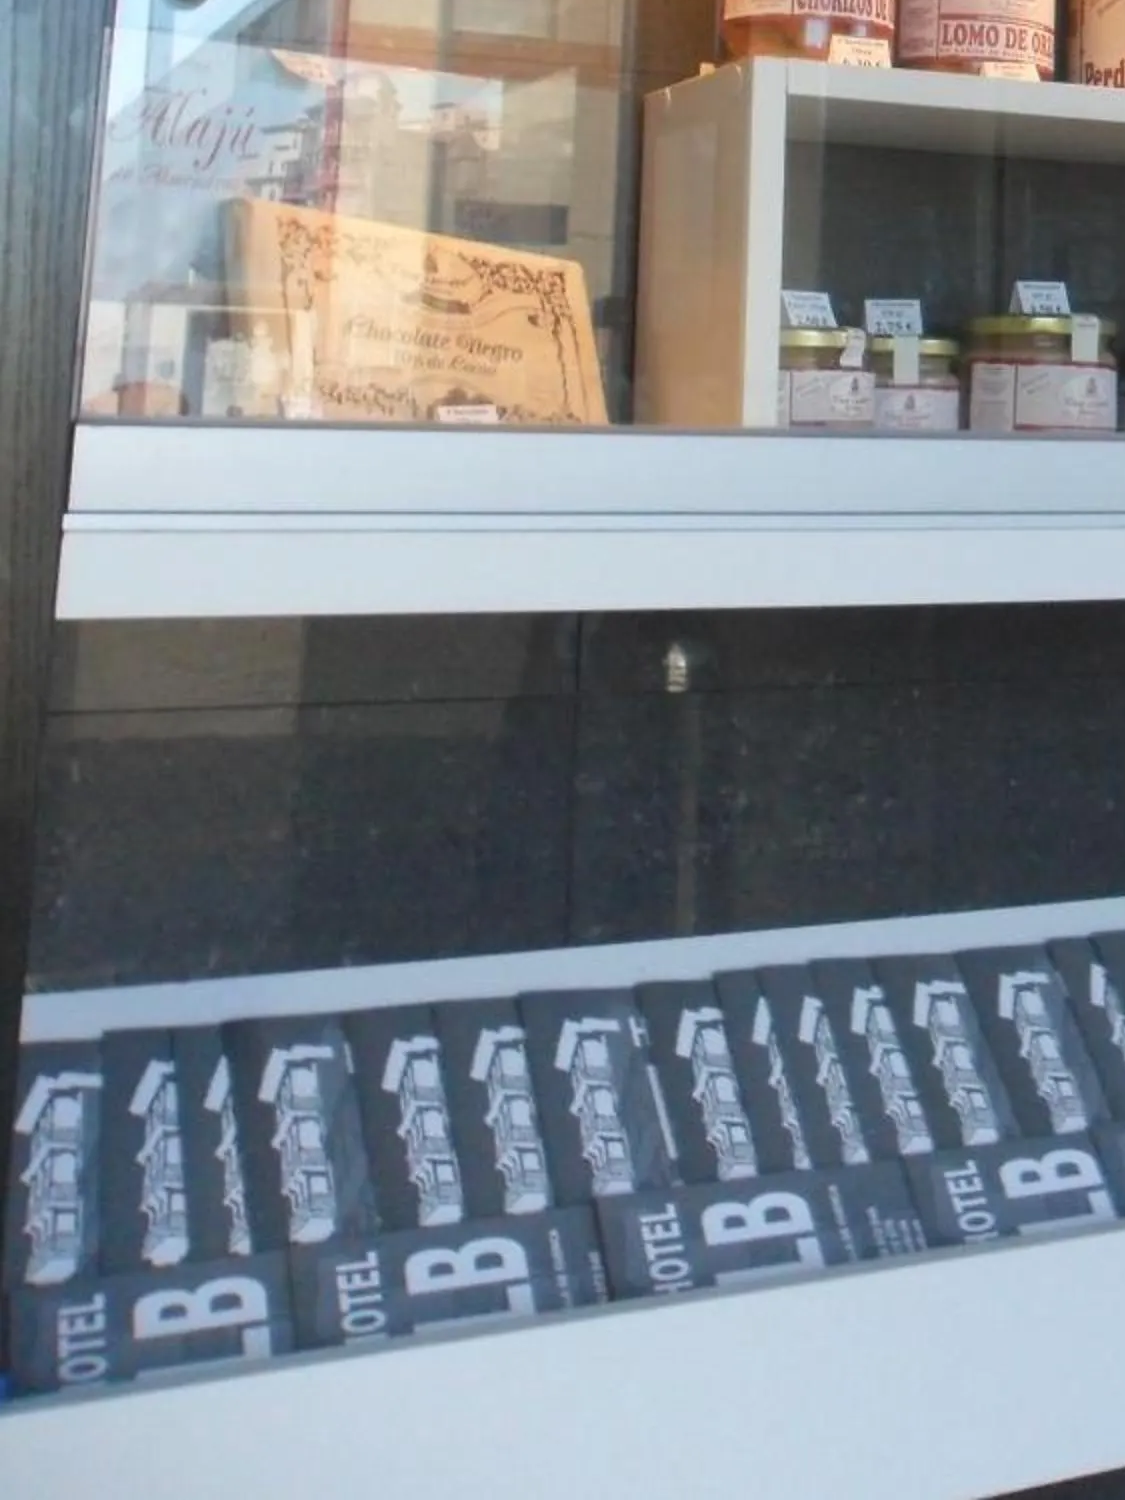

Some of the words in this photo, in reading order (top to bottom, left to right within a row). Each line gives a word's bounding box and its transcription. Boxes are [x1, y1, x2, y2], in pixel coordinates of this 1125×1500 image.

[941, 22, 1000, 47] LOMO
[1005, 26, 1029, 51] DE
[57, 1292, 108, 1382] OTEL
[336, 1250, 388, 1338] OTEL
